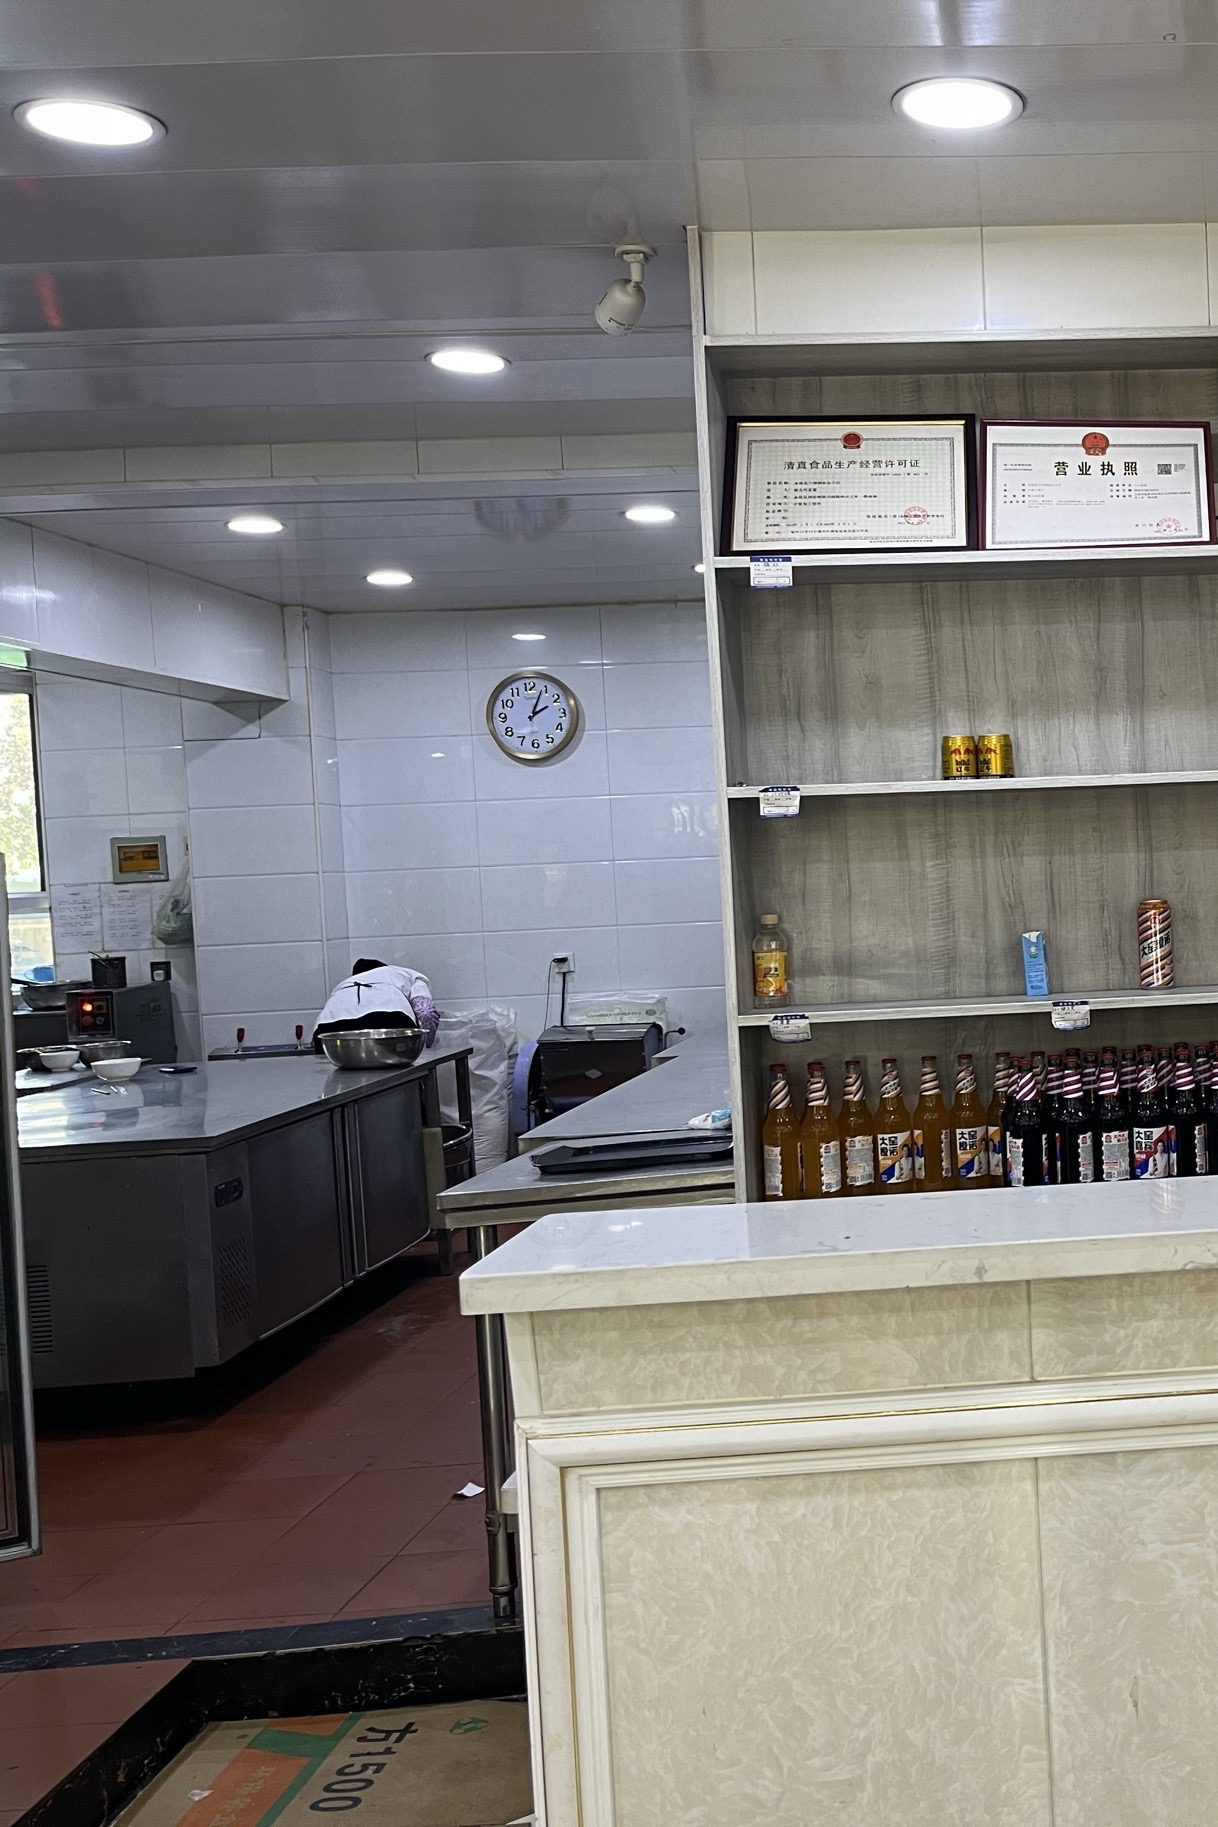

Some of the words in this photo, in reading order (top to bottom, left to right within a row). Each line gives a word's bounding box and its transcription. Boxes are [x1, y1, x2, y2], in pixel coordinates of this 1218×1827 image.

[784, 459, 920, 470] 清真食品生产经营许可证
[1054, 461, 1139, 476] 营业执照
[511, 688, 520, 697] 11
[524, 682, 536, 693] 12
[552, 694, 560, 703] 2
[501, 699, 514, 709] 10
[499, 713, 507, 723] 9
[559, 708, 567, 719] 3
[505, 727, 514, 737] 8
[556, 723, 563, 732] 4
[517, 736, 526, 746] 7
[532, 739, 540, 749] 6
[546, 734, 554, 744] 5
